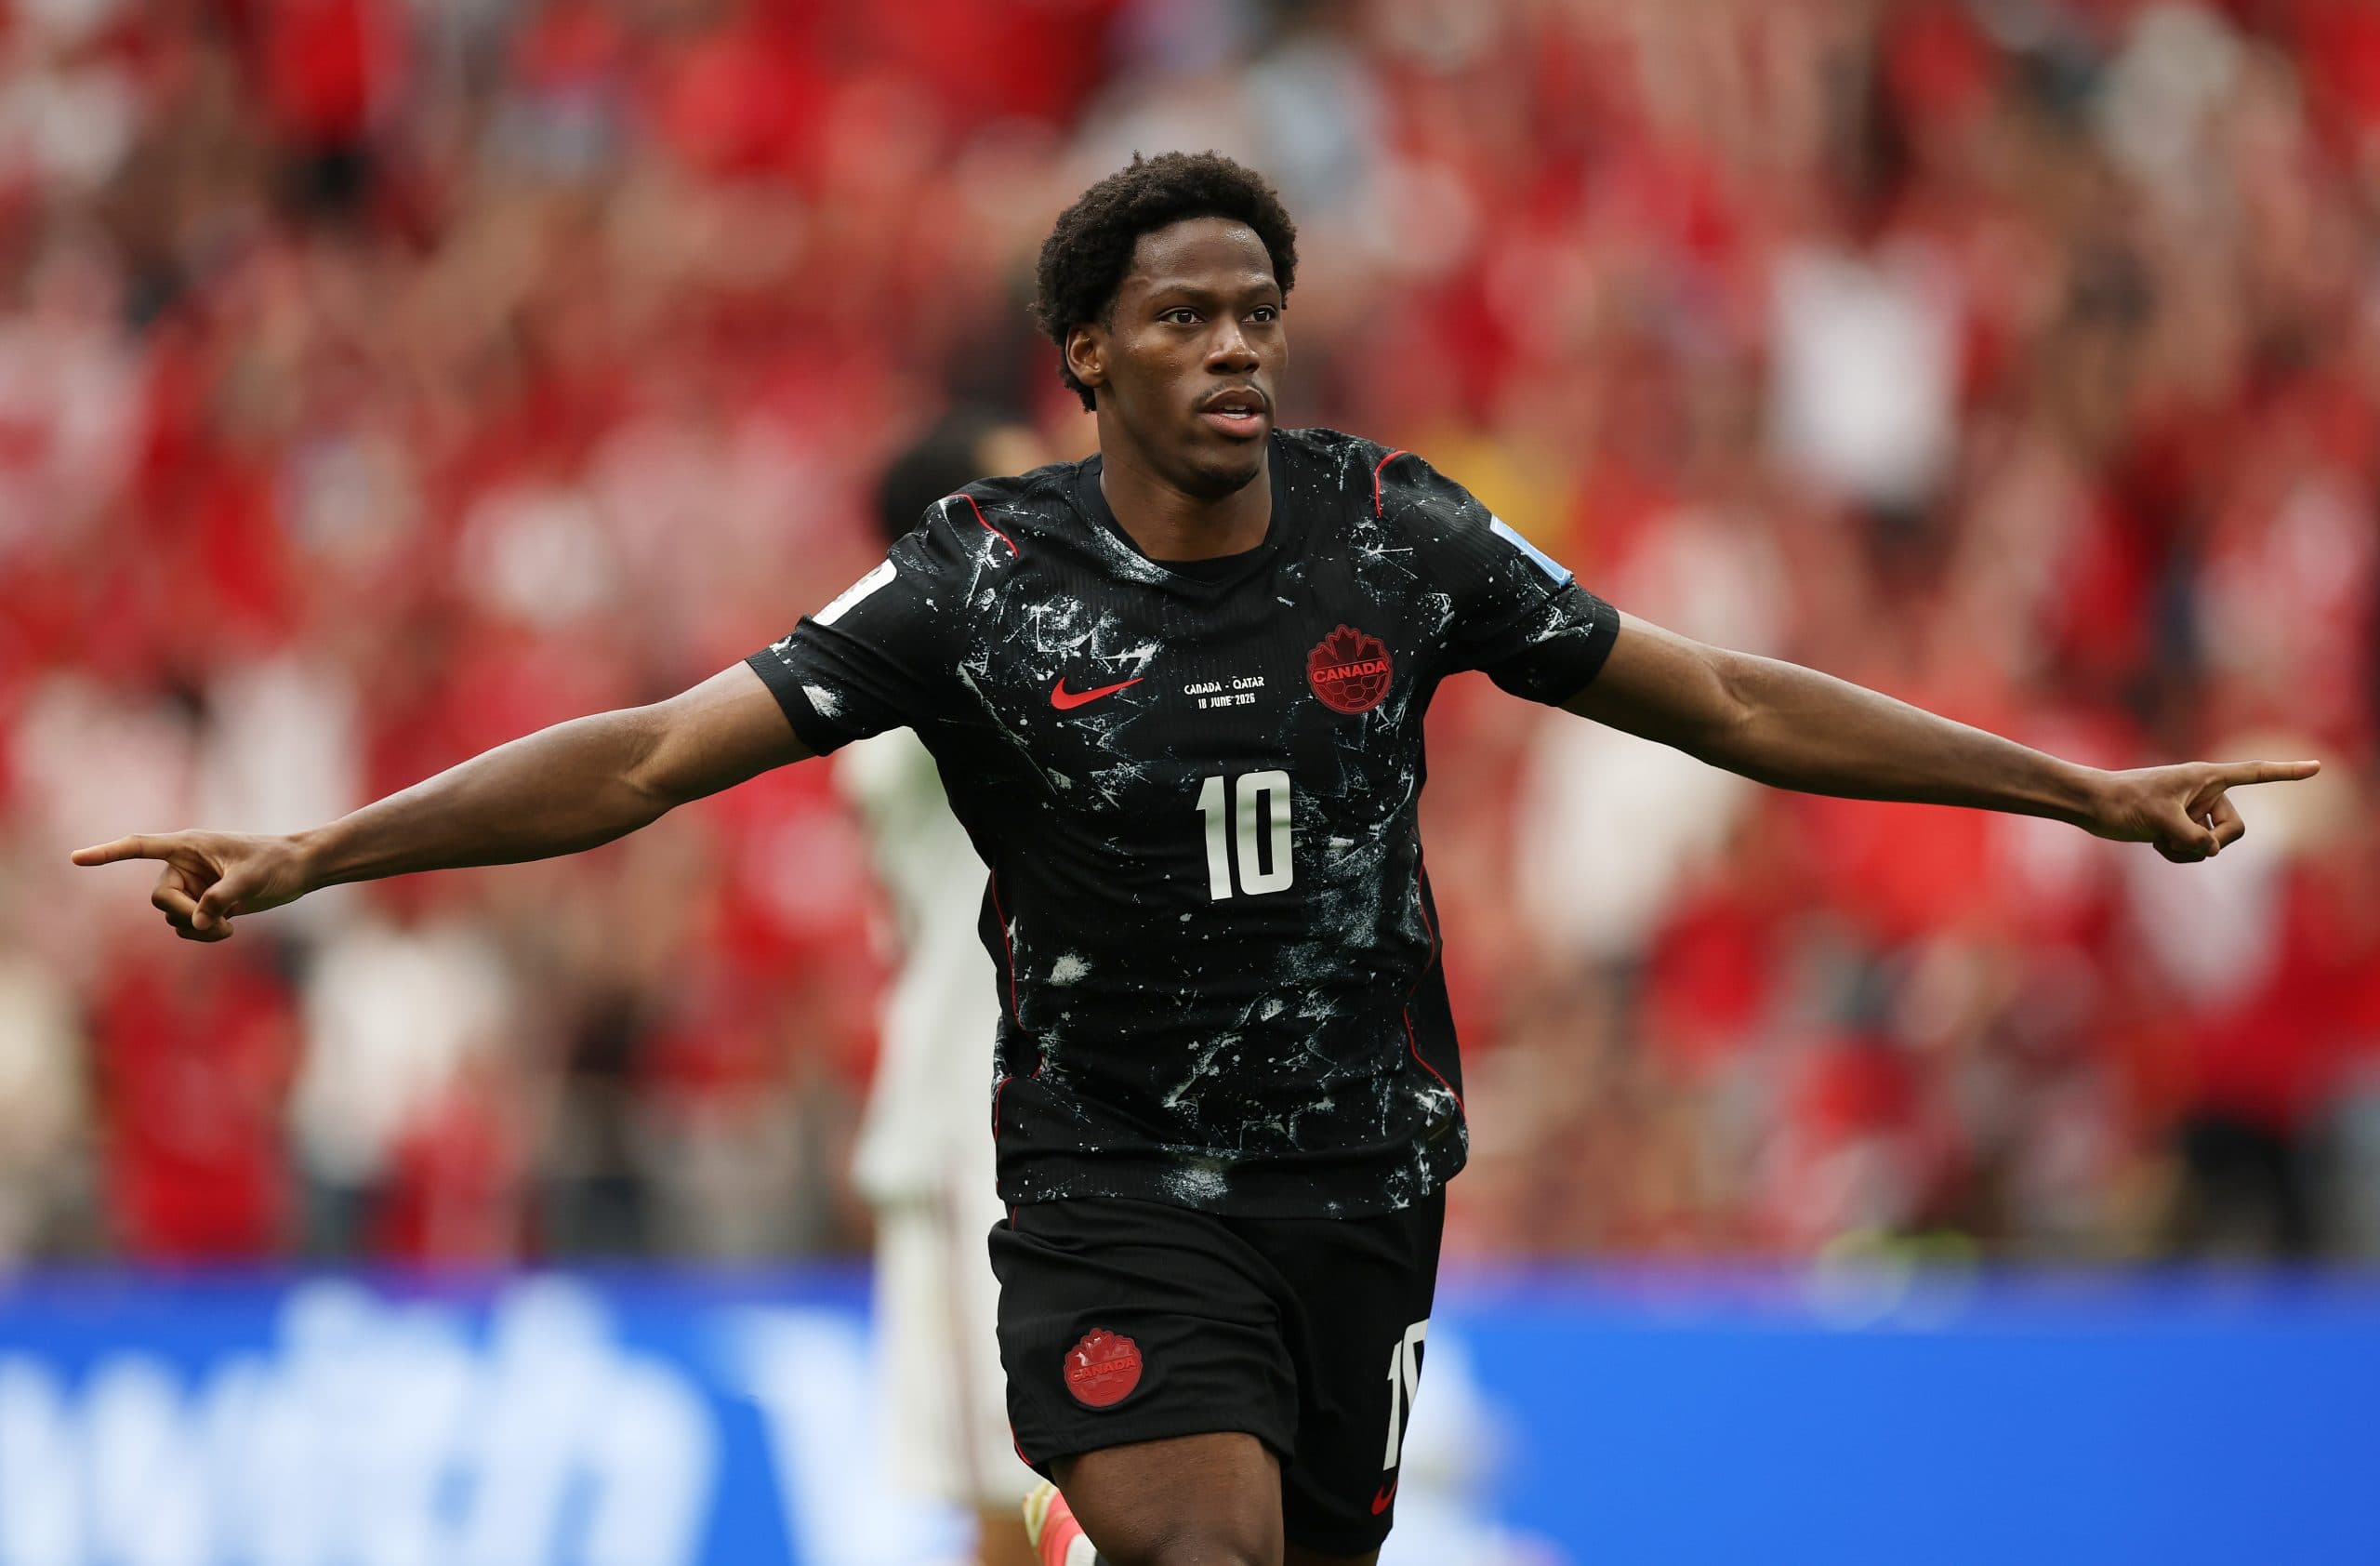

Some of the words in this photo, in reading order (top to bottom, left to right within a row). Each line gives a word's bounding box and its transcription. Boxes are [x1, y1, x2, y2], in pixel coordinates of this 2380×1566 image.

[1313, 661, 1388, 683] CANADA
[1183, 682, 1223, 695] CANADA
[1232, 676, 1264, 689] QATAR
[1198, 697, 1208, 709] 18
[1210, 696, 1232, 708] JUNE
[1235, 693, 1256, 705] 2026
[1196, 770, 1293, 900] 10
[1070, 1358, 1137, 1381] CANADA
